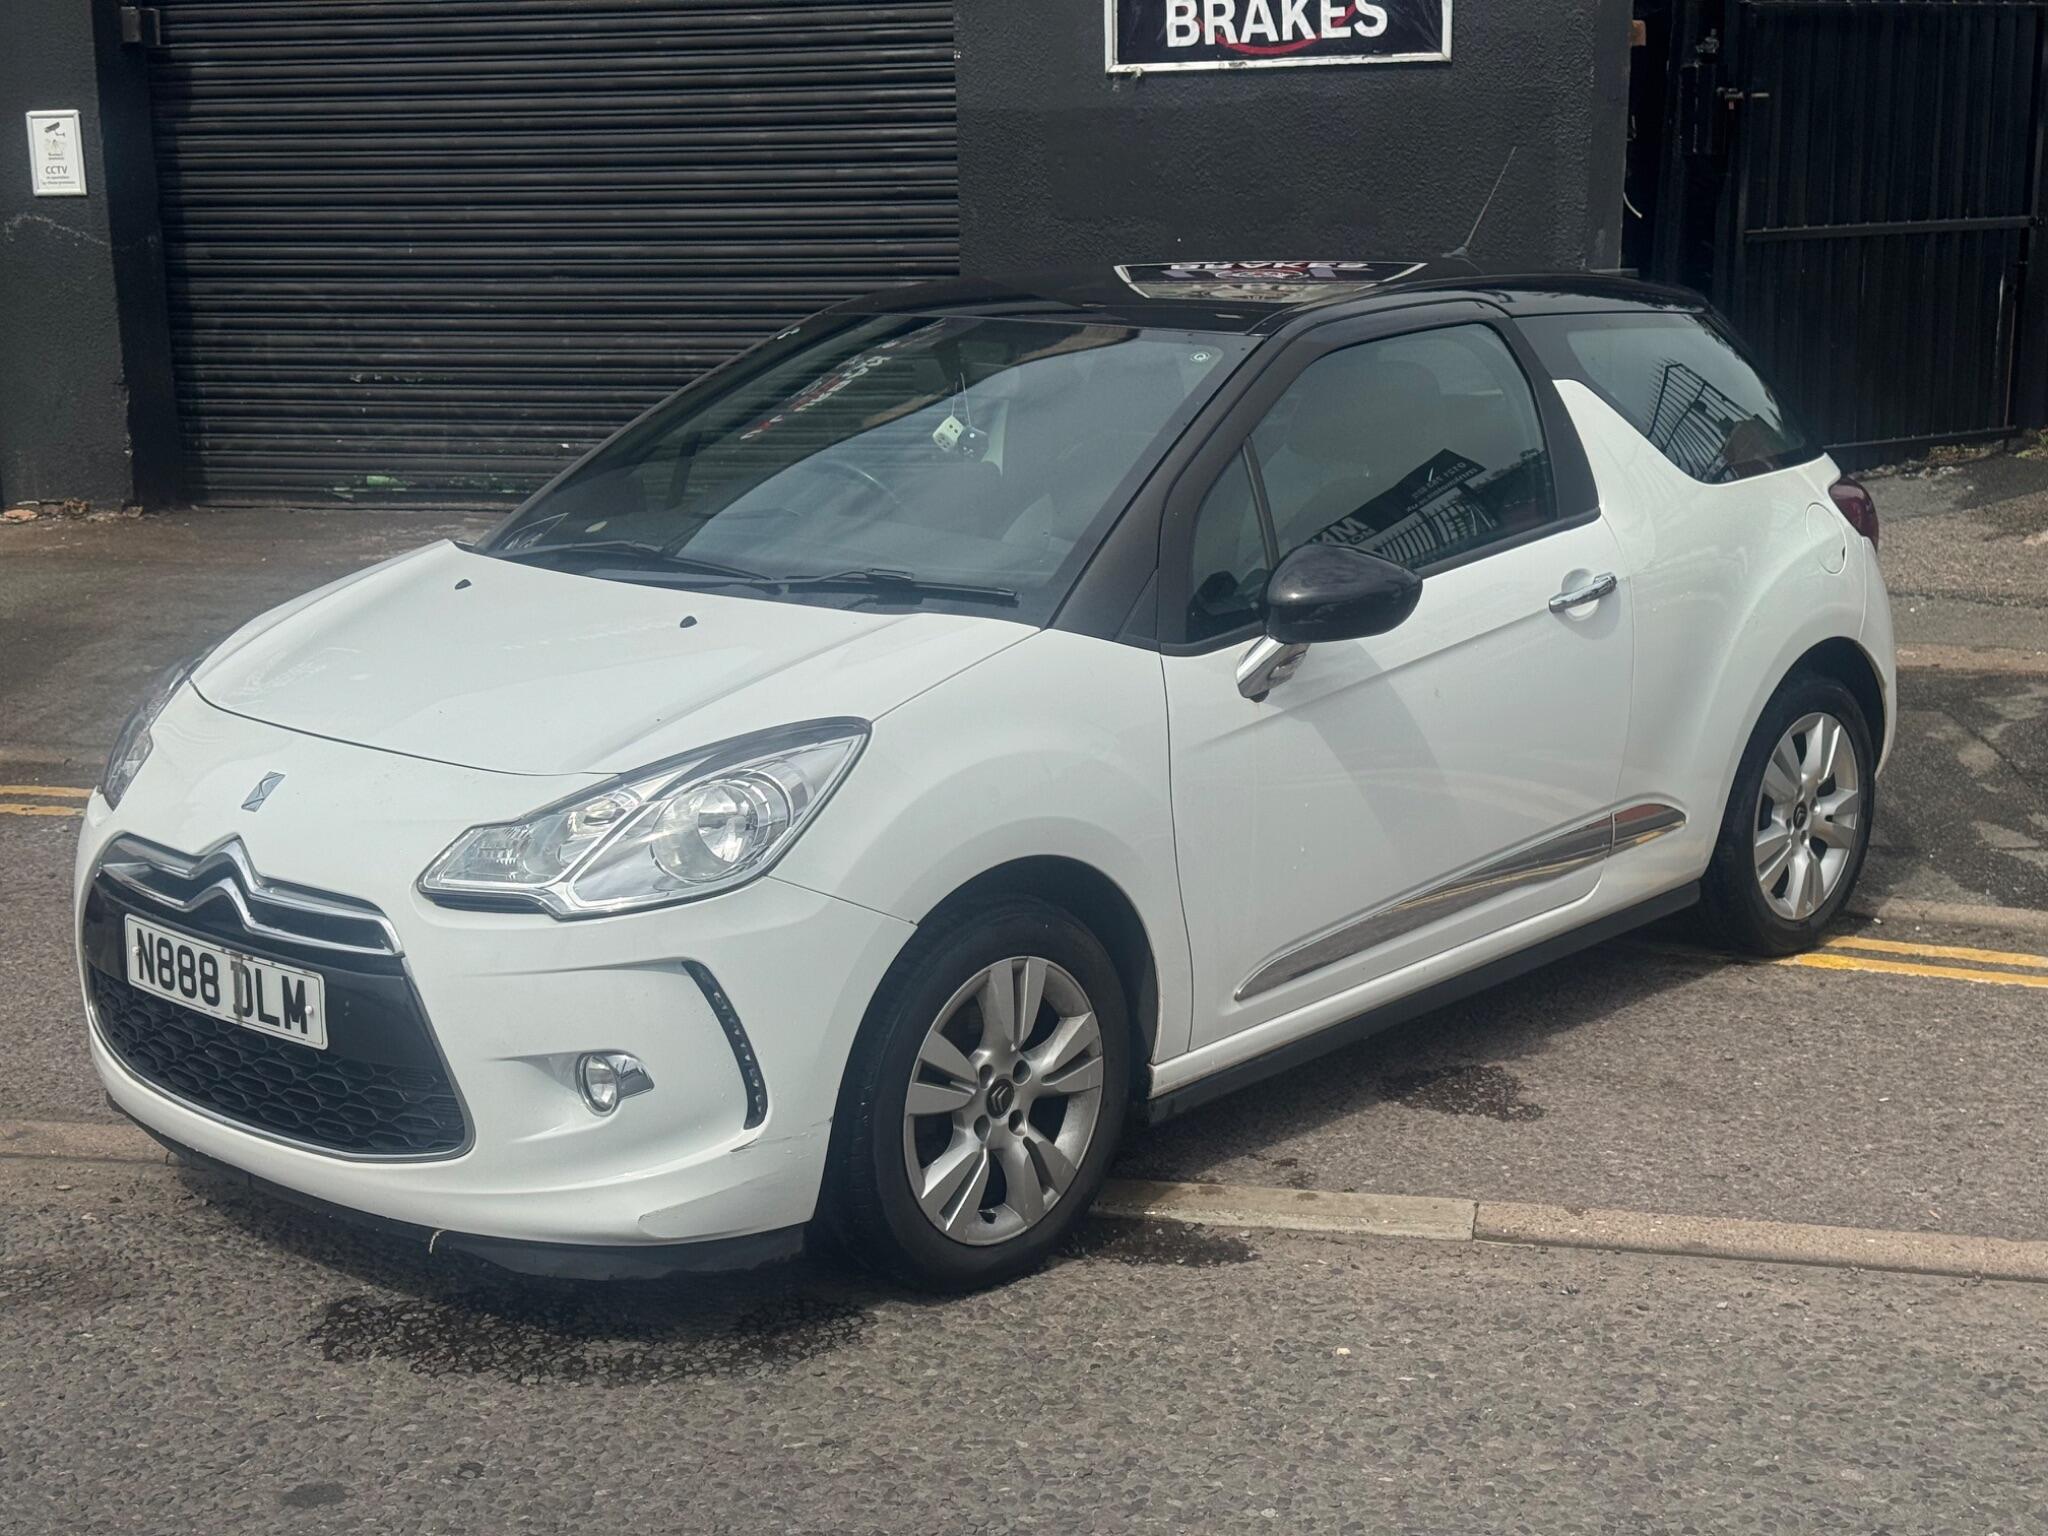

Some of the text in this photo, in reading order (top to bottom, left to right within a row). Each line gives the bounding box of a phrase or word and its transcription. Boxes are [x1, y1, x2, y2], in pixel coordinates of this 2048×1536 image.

[1166, 0, 1388, 47] BRAKES
[45, 165, 68, 175] CCTV
[137, 928, 308, 1035] N888 DLM
